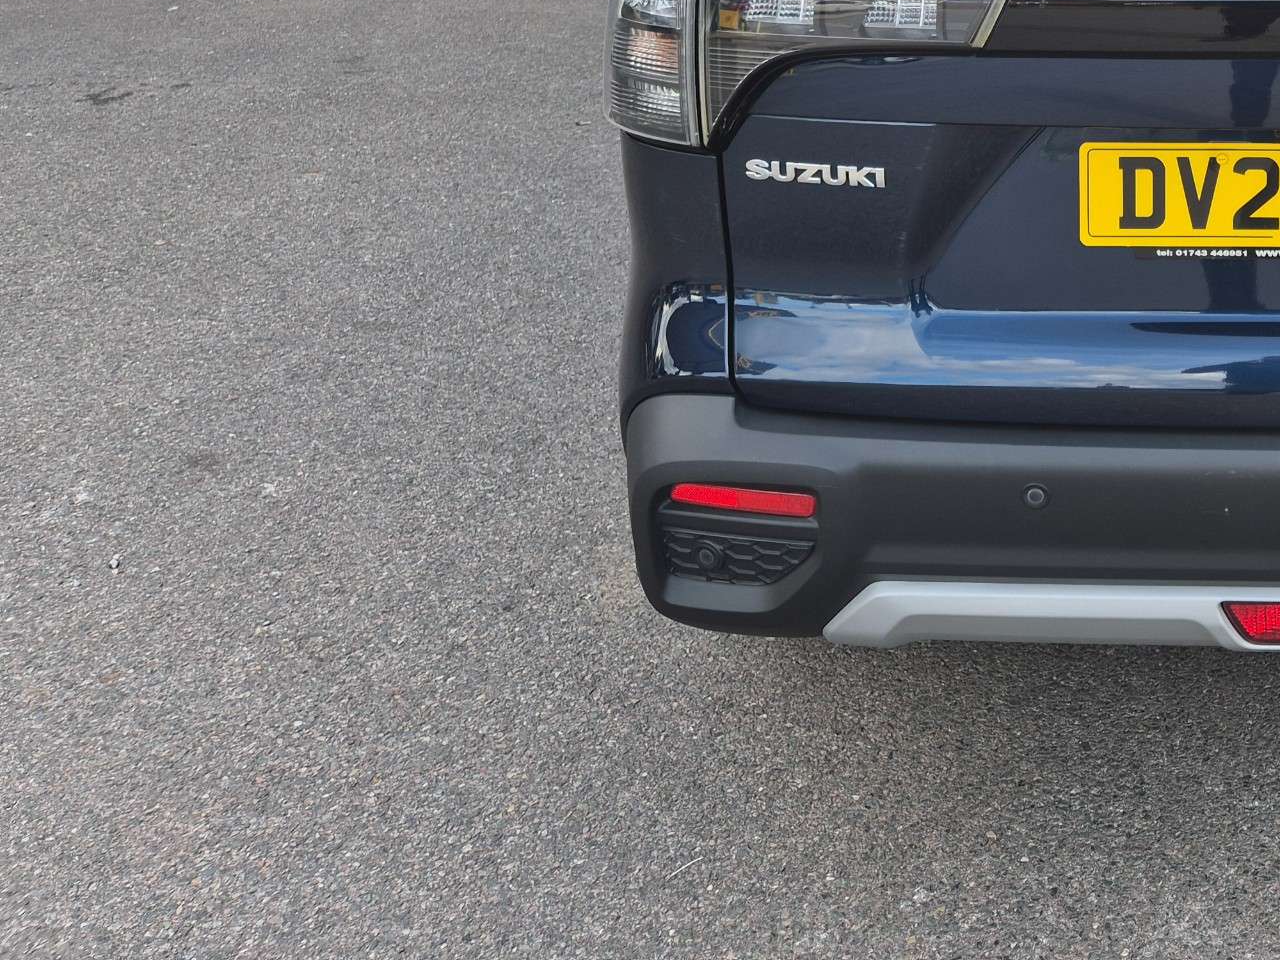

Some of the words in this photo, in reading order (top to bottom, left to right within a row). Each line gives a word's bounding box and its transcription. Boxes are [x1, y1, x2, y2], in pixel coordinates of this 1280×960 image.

[745, 158, 886, 188] SUZUKI
[1156, 249, 1173, 257] tel:
[1175, 249, 1208, 257] 01743
